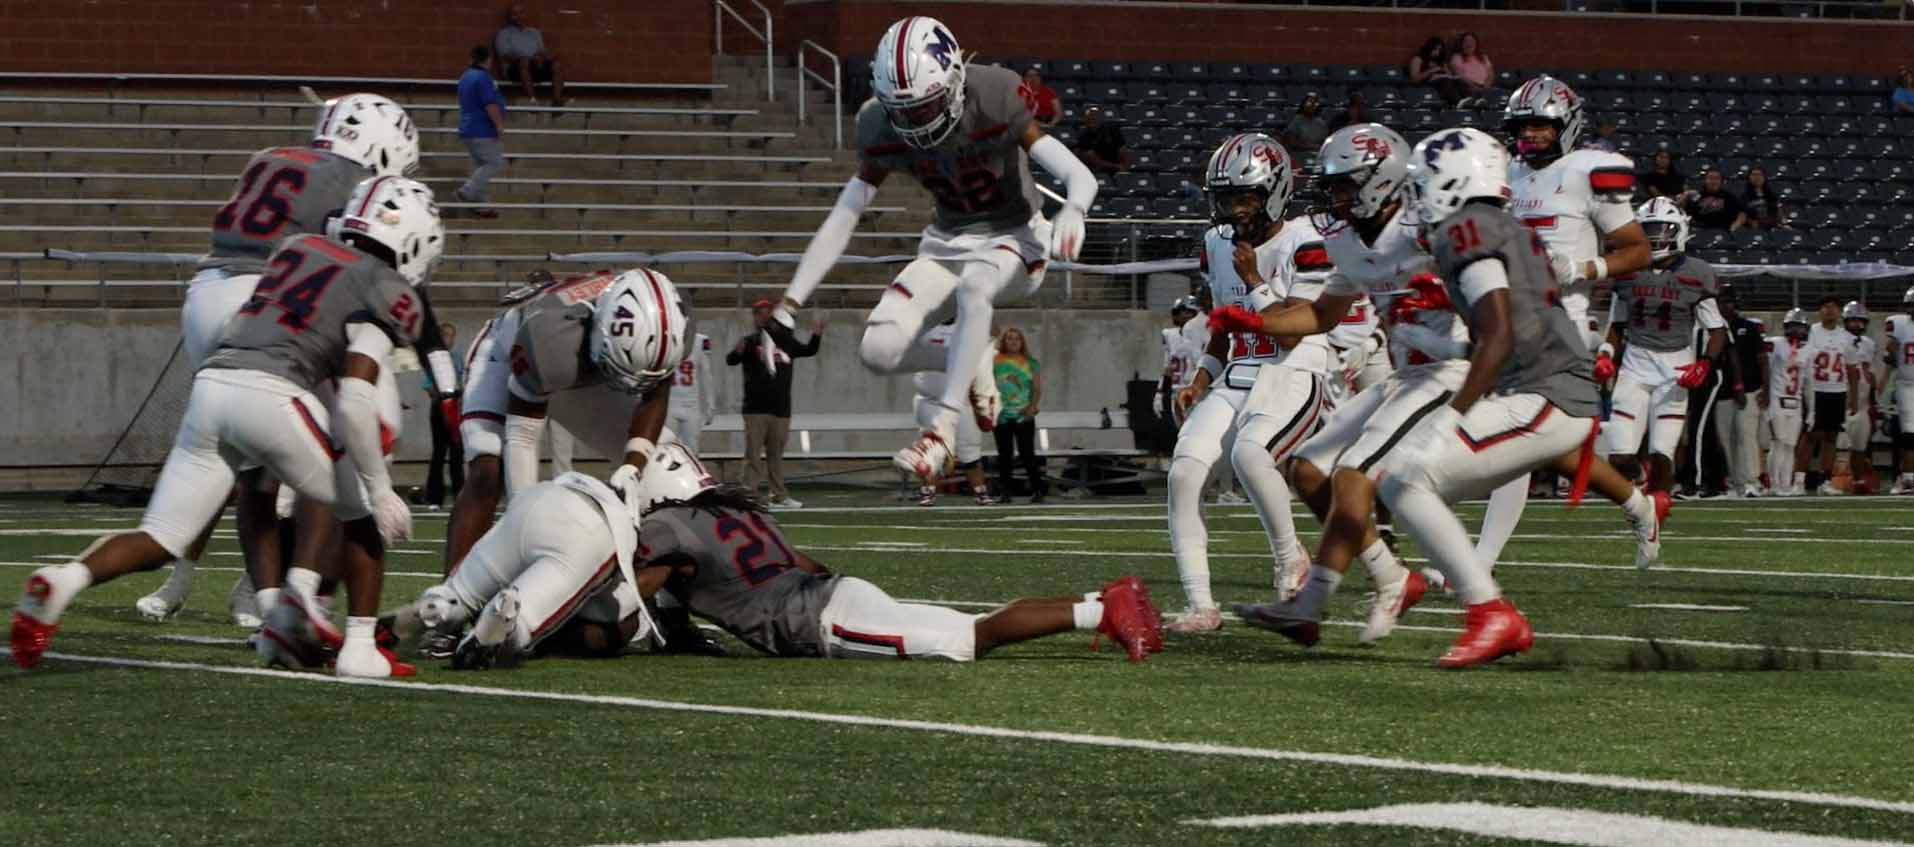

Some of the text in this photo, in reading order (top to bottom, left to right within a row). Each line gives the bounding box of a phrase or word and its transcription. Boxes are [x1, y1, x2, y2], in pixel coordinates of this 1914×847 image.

[212, 160, 308, 240] 16
[1448, 217, 1481, 253] 31
[240, 248, 344, 336] 24
[609, 304, 635, 337] 45
[1815, 352, 1845, 384] 24
